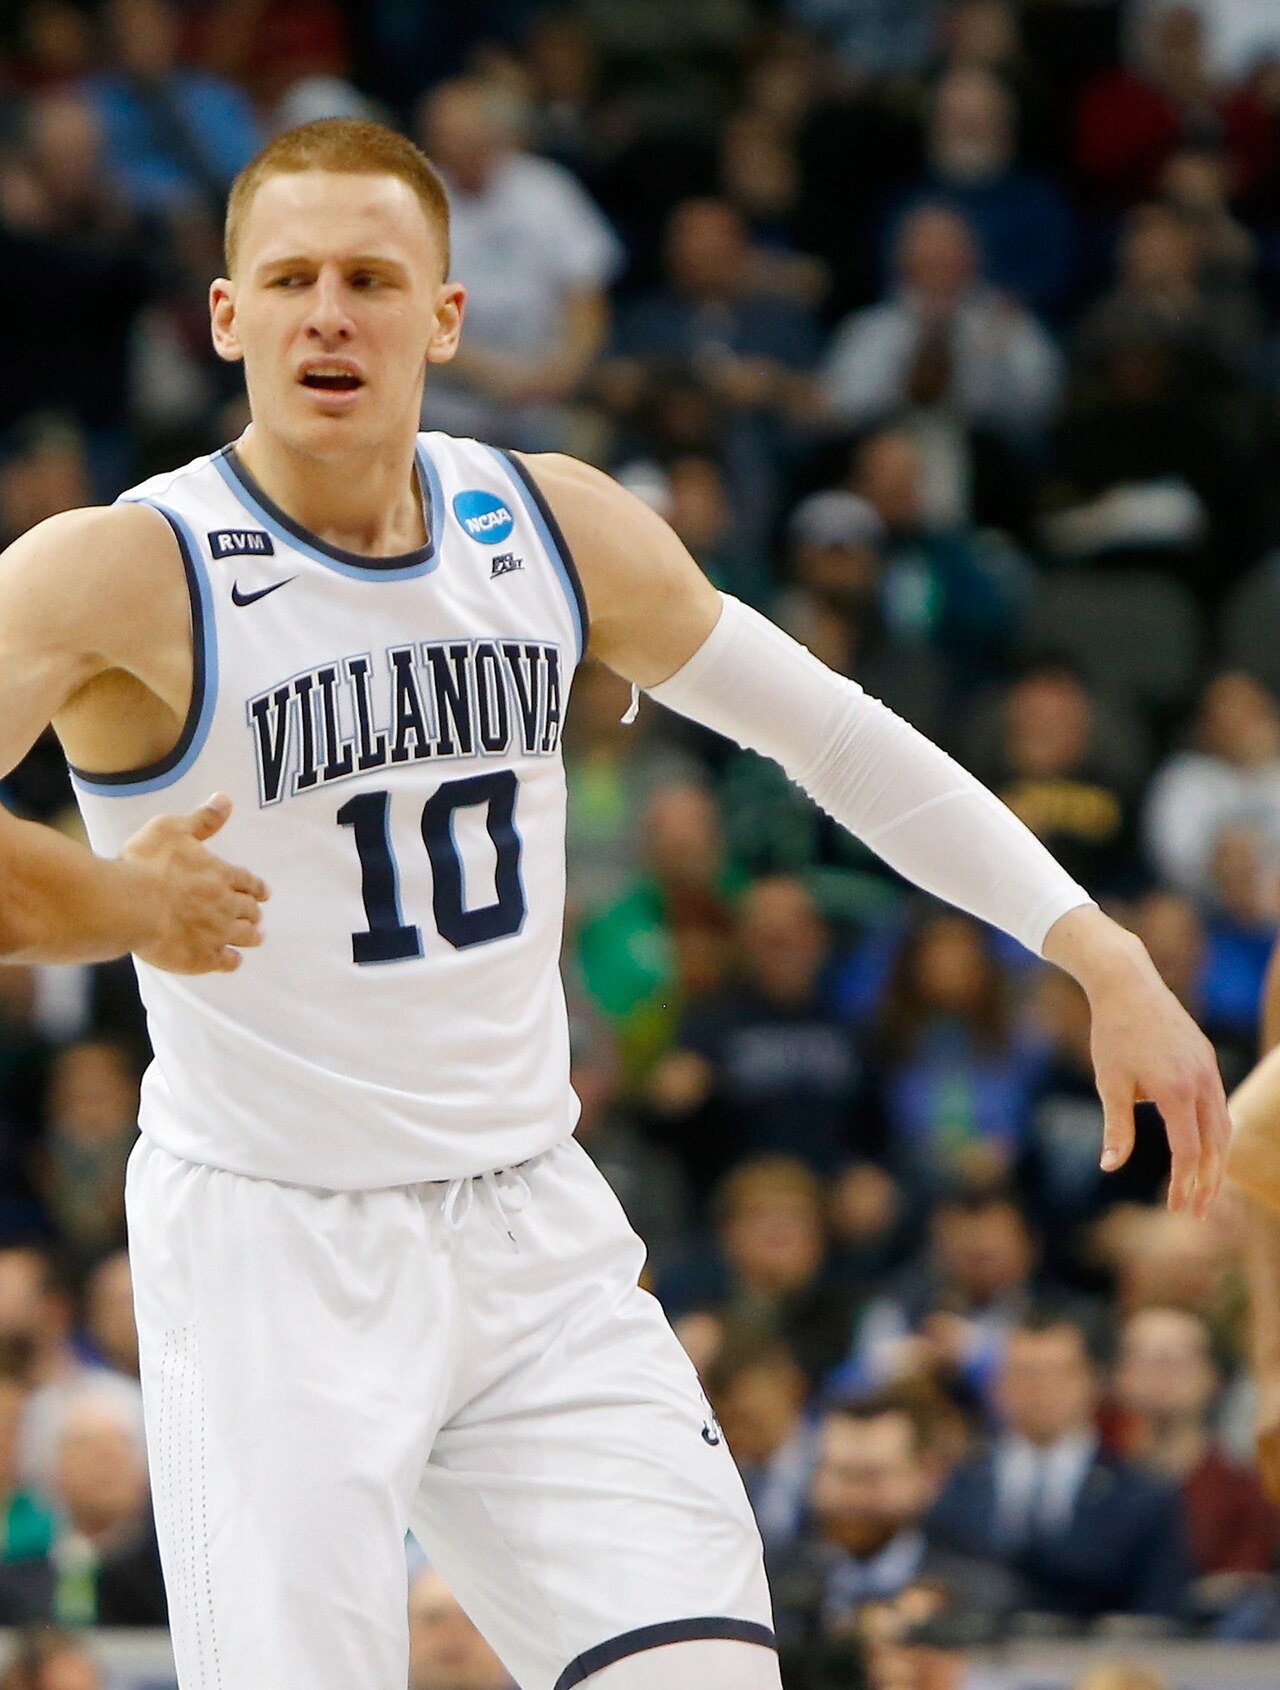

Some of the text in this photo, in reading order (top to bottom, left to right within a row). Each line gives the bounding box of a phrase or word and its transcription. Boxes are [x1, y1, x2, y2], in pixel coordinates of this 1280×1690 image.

[217, 533, 265, 551] RVM
[465, 507, 513, 533] NCAA
[246, 639, 561, 808] VILLANOVA
[336, 769, 528, 965] 10
